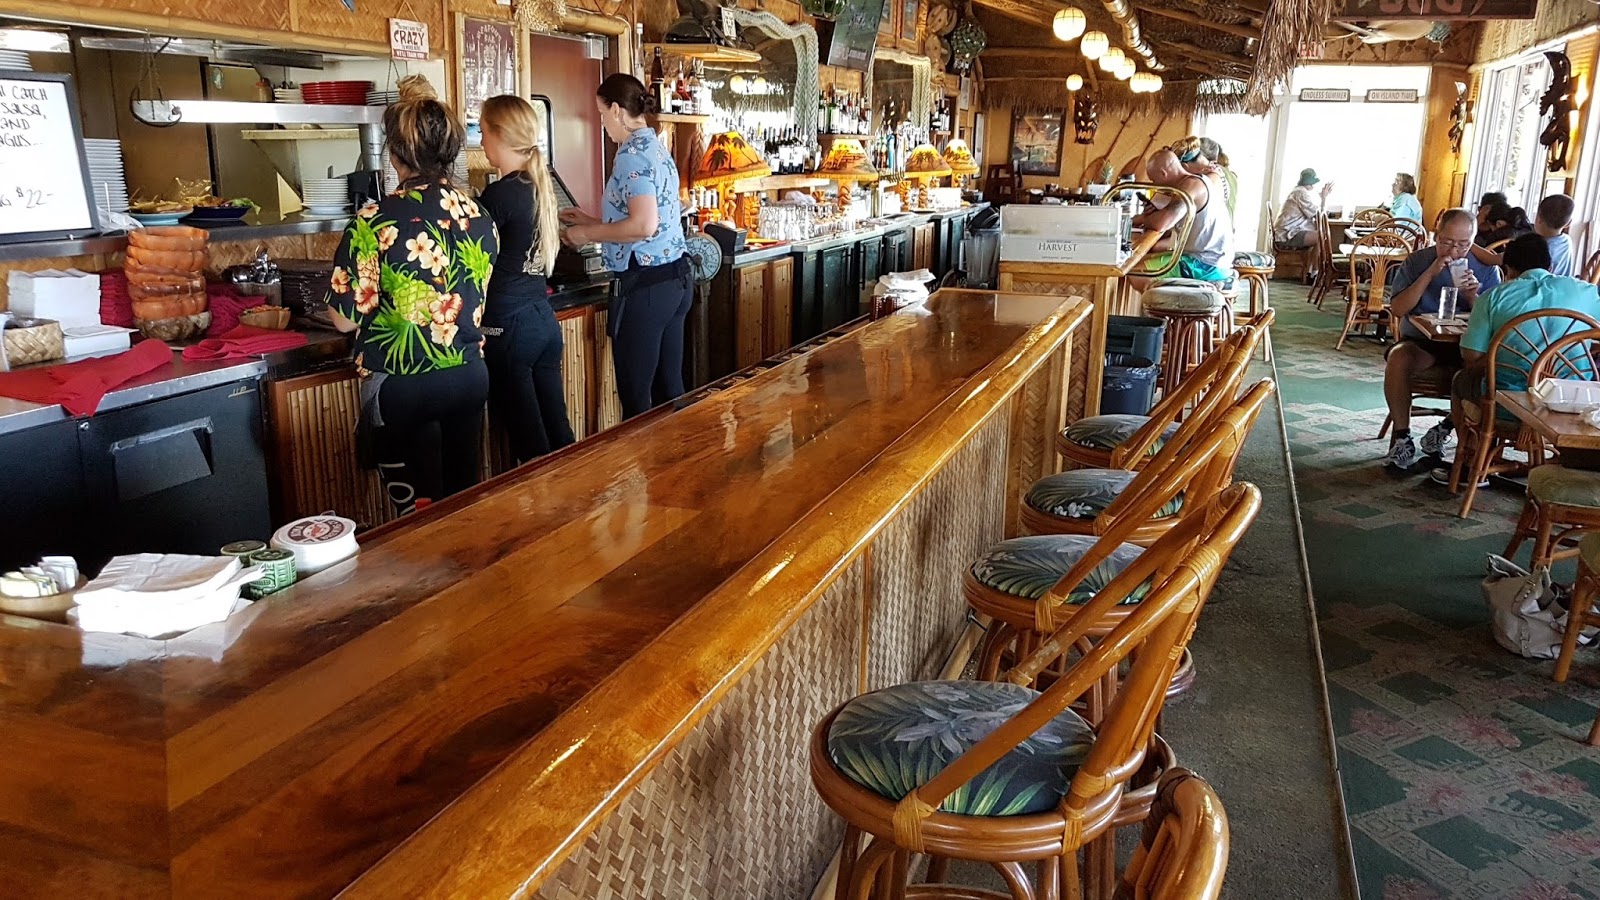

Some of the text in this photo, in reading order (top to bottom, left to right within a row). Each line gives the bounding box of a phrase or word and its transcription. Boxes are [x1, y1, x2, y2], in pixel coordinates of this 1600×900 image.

[394, 30, 425, 46] CRAZY
[1303, 91, 1347, 99] ENDLESS SUMMER
[1038, 242, 1078, 251] HARVEST
